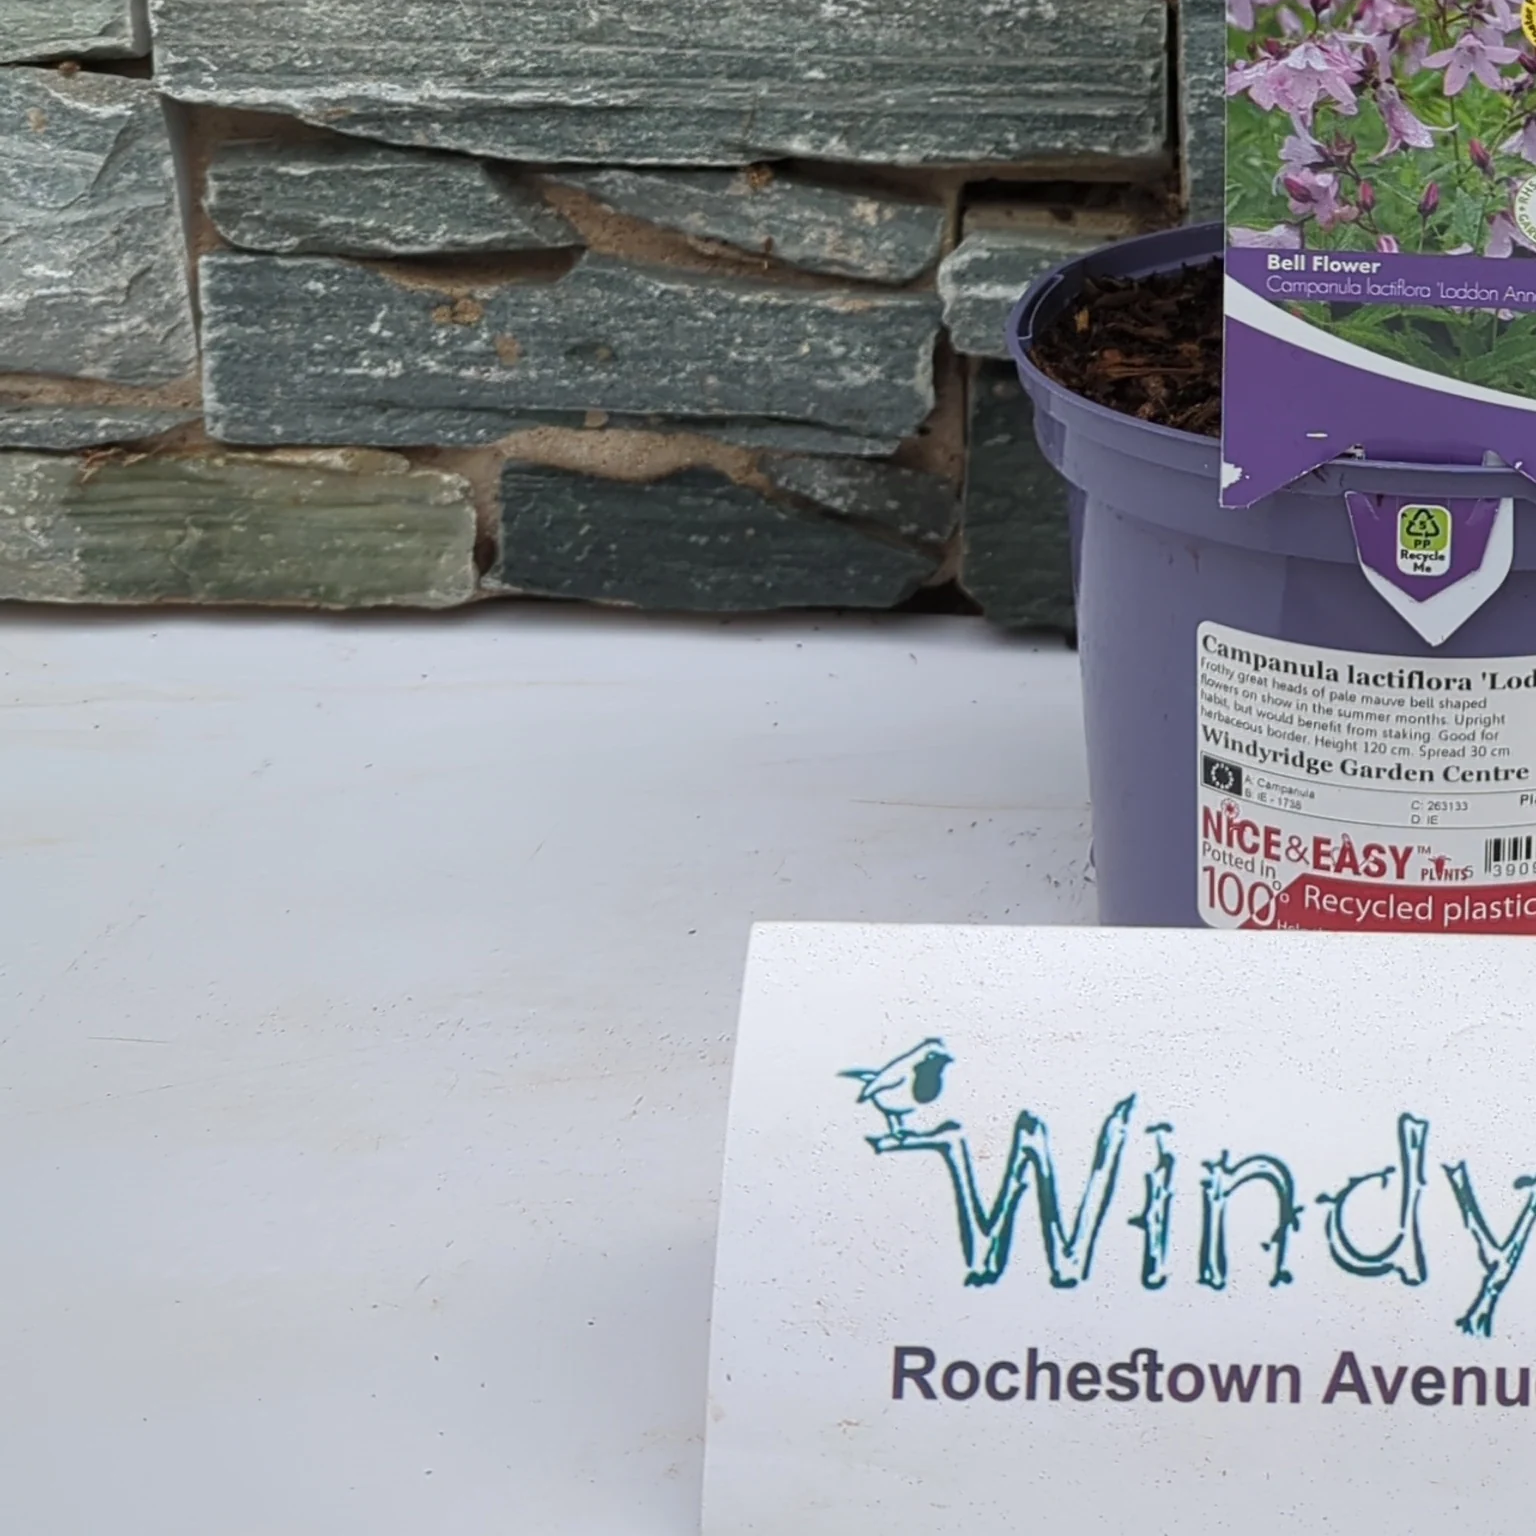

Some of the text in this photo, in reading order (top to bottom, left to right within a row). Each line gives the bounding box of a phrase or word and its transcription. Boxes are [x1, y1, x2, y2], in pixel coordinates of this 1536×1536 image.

[1267, 254, 1382, 274] Bell Flower
[1266, 275, 1363, 297] Campanula
[1366, 278, 1432, 299] lactiflora
[1400, 549, 1446, 563] Recycle
[1414, 539, 1431, 549] PP
[1413, 562, 1432, 572] Me
[1202, 634, 1340, 683] Campanula
[1347, 664, 1473, 692] lactiflora
[1200, 656, 1488, 713] Frothy great heads of pale mauve bell shaped
[1200, 672, 1239, 696] flowers
[1242, 689, 1258, 702] on
[1261, 691, 1293, 709] show
[1296, 698, 1309, 712] in
[1312, 702, 1334, 716] the
[1338, 707, 1392, 724] summer
[1454, 712, 1506, 730] Upright
[1200, 704, 1264, 735] herbaceous
[1266, 724, 1311, 745] border.
[1314, 734, 1358, 753] Height
[1363, 740, 1388, 754] 120
[1419, 744, 1467, 761] Spread
[1470, 745, 1488, 758] 30
[1490, 746, 1511, 758] cm
[1233, 699, 1253, 716] but
[1256, 707, 1295, 725] would
[1298, 714, 1342, 734] benefit
[1346, 722, 1378, 738] from
[1438, 729, 1477, 742] Good
[1480, 728, 1500, 741] for
[1202, 723, 1530, 783] Windyridge Garden Centre
[1256, 776, 1316, 800] Campanula
[1427, 800, 1469, 811] 263133
[1427, 814, 1439, 825] IE
[1202, 840, 1277, 881] Potted in
[1303, 884, 1433, 921] Recycled
[892, 1346, 1301, 1405] Rochestown
